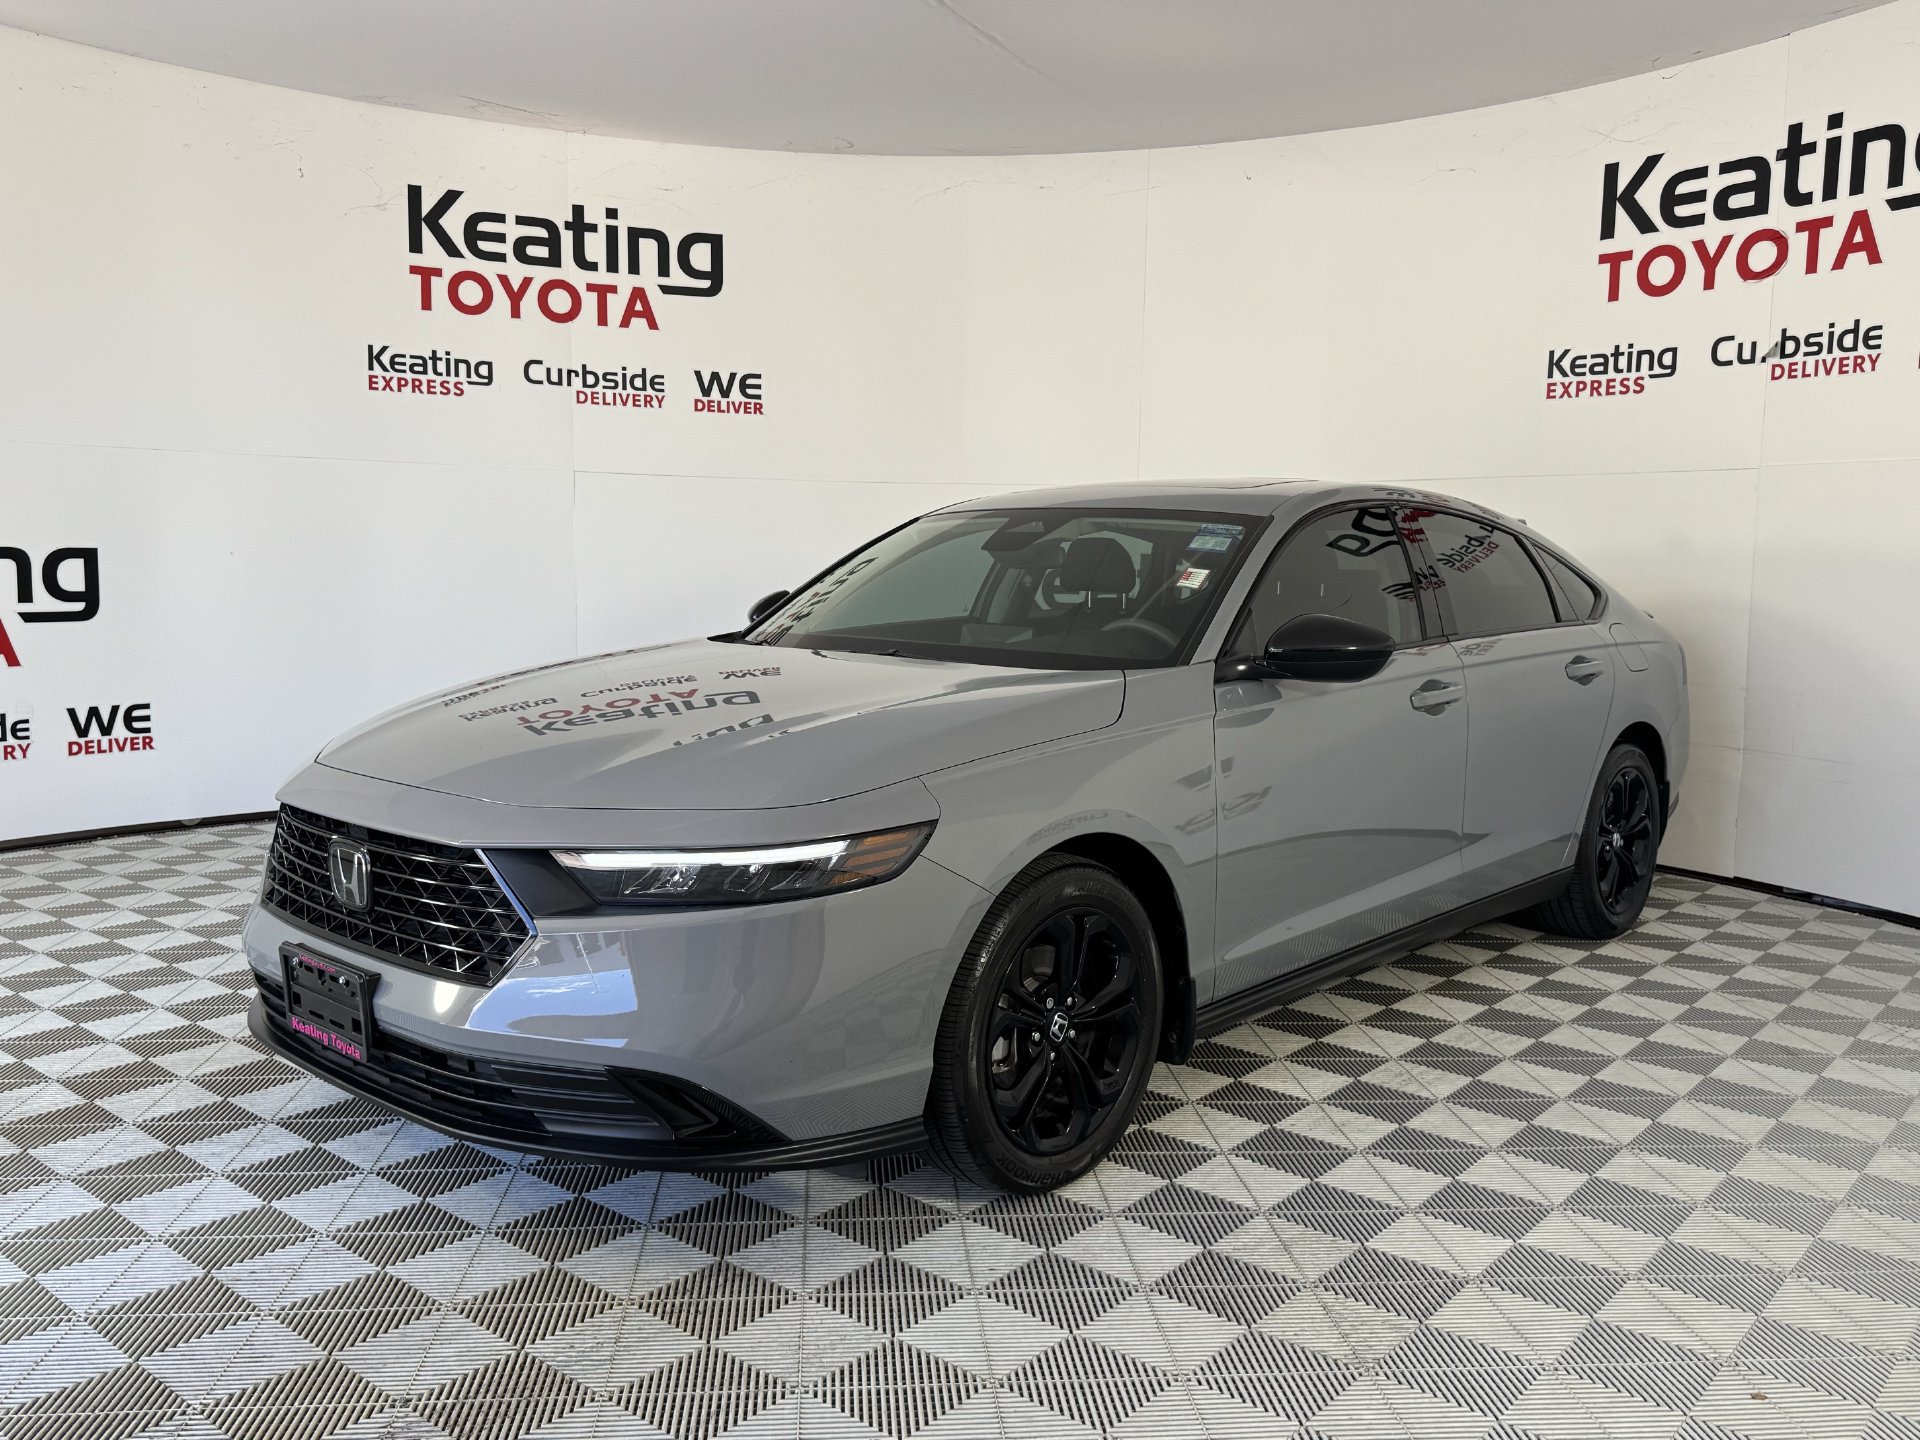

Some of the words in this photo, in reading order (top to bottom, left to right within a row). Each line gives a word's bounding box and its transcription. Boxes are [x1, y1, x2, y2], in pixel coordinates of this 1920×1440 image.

[1600, 111, 1920, 240] Keatin
[407, 184, 724, 298] Keating
[1598, 209, 1882, 303] TOYOTA
[409, 264, 660, 331] TOYOTA
[1711, 319, 1883, 367] Cubside
[367, 344, 494, 387] Keating
[523, 359, 665, 393] Curbside
[1547, 343, 1678, 380] Keating
[1770, 353, 1881, 381] DELIVERY
[368, 374, 465, 397] EXPRESS
[576, 390, 665, 409] DELIVERY
[694, 370, 762, 400] WE
[1545, 375, 1646, 400] EXPRESS
[694, 398, 764, 415] DELIVER
[66, 703, 152, 739] WE
[67, 736, 155, 757] DELIVER
[291, 1016, 329, 1047] Keating
[331, 1033, 361, 1060] Toyota
